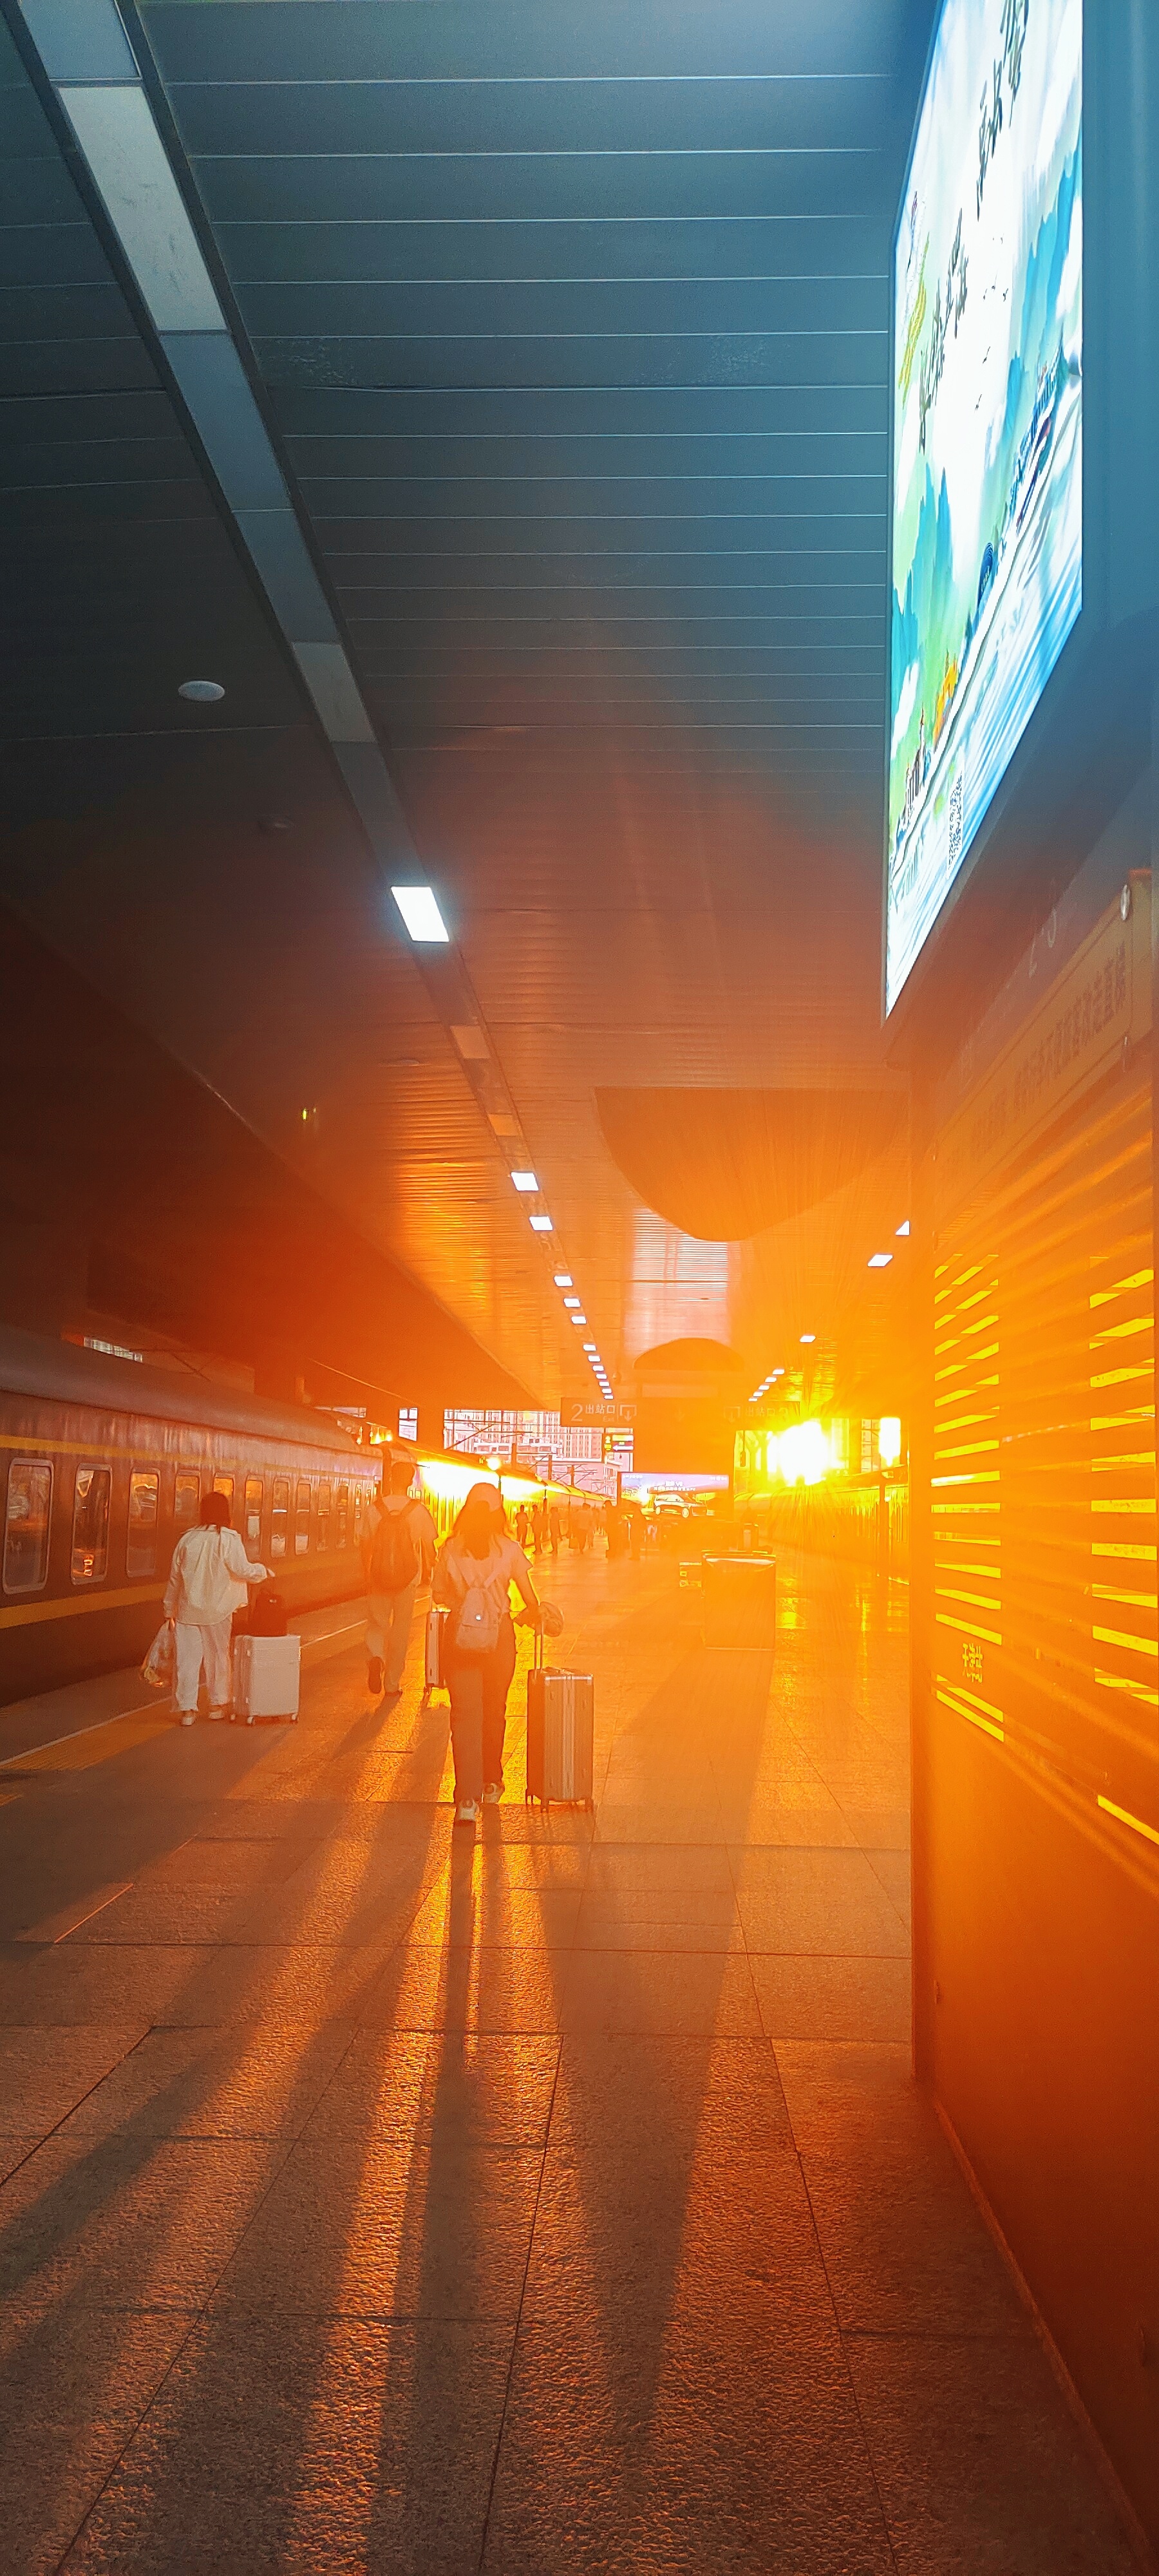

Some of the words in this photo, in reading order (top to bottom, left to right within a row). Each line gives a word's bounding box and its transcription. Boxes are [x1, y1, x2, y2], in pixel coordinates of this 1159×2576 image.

[571, 1404, 583, 1422] 2
[586, 1404, 616, 1414] 出站口
[746, 1406, 775, 1417] 出站口
